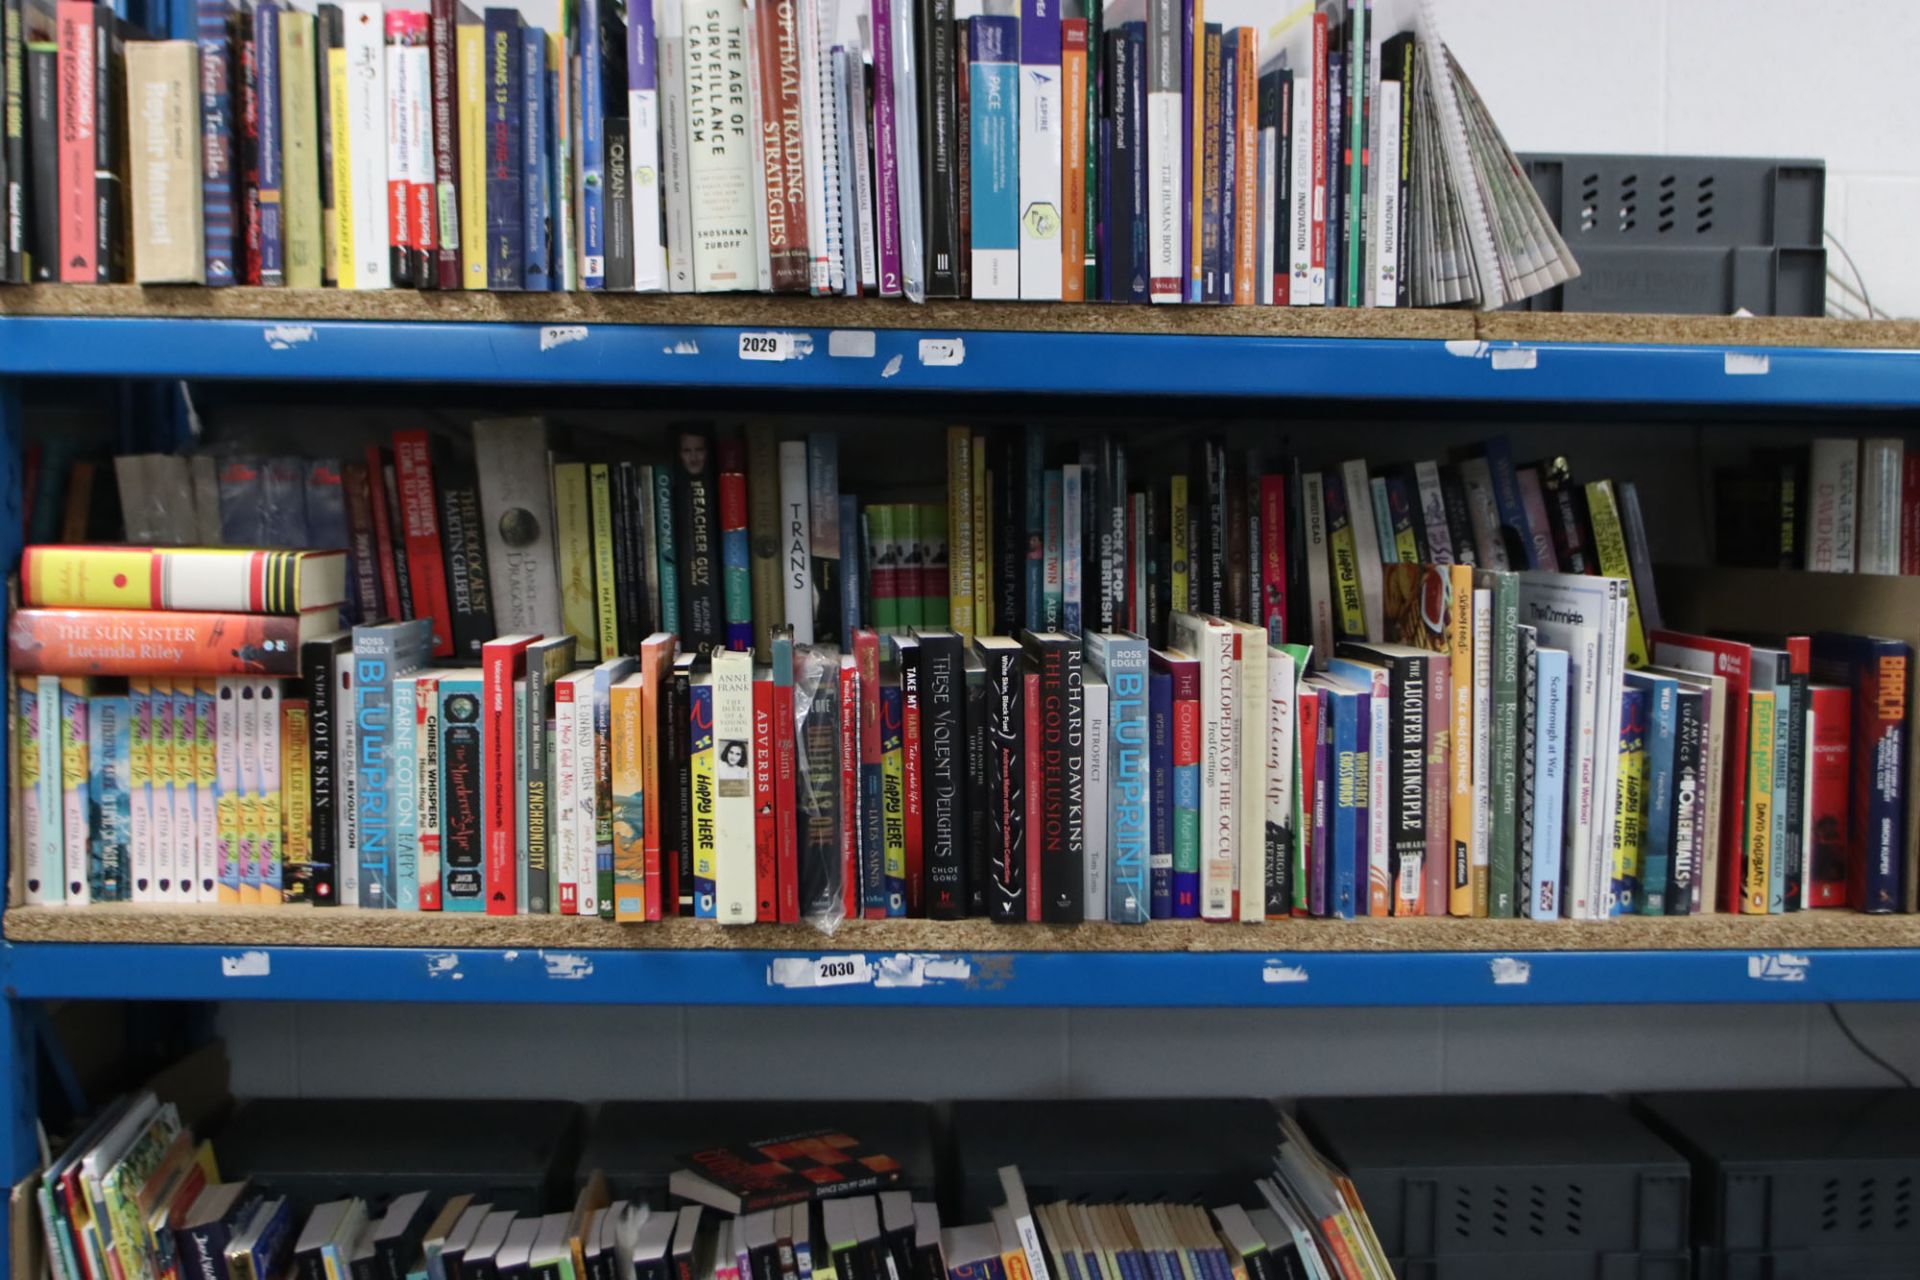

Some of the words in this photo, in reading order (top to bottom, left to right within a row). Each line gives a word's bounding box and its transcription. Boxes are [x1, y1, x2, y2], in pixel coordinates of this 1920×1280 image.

[64, 19, 75, 51] NEW
[727, 28, 741, 61] THE
[777, 2, 800, 100] OPTIMAL
[1116, 39, 1125, 63] Staff
[78, 24, 91, 125] INTRODUCING
[203, 40, 221, 107] African
[527, 44, 538, 74] Faith
[64, 56, 76, 142] ECONOMICS
[527, 77, 538, 99] and
[688, 25, 705, 143] CAPITALISM
[707, 10, 725, 156] SURVEILLANCE
[729, 70, 743, 105] AGE
[988, 76, 1001, 109] PACE
[1115, 64, 1126, 113] Well-Being
[79, 127, 90, 139] A
[141, 81, 170, 156] Repair
[528, 101, 539, 165] Resistance
[731, 115, 744, 136] OF
[1116, 115, 1126, 149] Journal
[206, 112, 223, 179] Textiles
[783, 104, 804, 203] TRADING
[1298, 144, 1307, 177] LENSES
[610, 143, 625, 198] QURAN
[764, 121, 786, 246] STRATEGIES
[1298, 179, 1306, 190] OF
[146, 162, 172, 245] Manual
[395, 182, 408, 241] Bescherelle
[697, 229, 749, 238] SHOSHANA
[1297, 192, 1306, 251] INNOVATION
[705, 241, 741, 249] ZUBOFF
[886, 272, 896, 288] 2
[741, 338, 777, 353] 2029
[693, 487, 707, 553] REACHER
[1112, 507, 1122, 548] ROCK
[790, 503, 805, 589] TRANS
[1101, 534, 1111, 555] ON
[1113, 553, 1123, 565] &
[695, 557, 709, 585] GUY
[1113, 569, 1123, 602] POP
[603, 587, 612, 615] MATT
[1101, 559, 1111, 622] BRITISH
[59, 624, 92, 641] THE
[95, 624, 134, 641] SUN
[137, 626, 196, 643] SISTER
[604, 617, 614, 642] HAIG
[1507, 607, 1517, 627] ROY
[66, 642, 136, 659] Lucinda
[140, 644, 183, 661] Riley
[354, 645, 390, 655] EDGLEY
[358, 637, 384, 645] ROSS
[1117, 650, 1143, 658] ROSS
[1505, 628, 1517, 682] STRONG
[718, 674, 749, 682] ANNE
[907, 667, 916, 691] TAKE
[932, 653, 951, 704] THESE
[1045, 649, 1060, 690] THE
[1111, 659, 1147, 667] EDGLEY
[1409, 660, 1420, 677] THE
[315, 665, 326, 707] UNDER
[495, 684, 502, 693] of
[717, 684, 749, 692] FRANK
[1000, 677, 1008, 694] Skin,
[1068, 650, 1082, 747] RICHARD
[1181, 674, 1192, 696] THE
[1220, 632, 1231, 754] ENCYCLOPEDIA
[1874, 656, 1906, 719] BARÇA
[907, 695, 917, 709] MY
[1001, 695, 1009, 715] Black
[1375, 704, 1383, 720] LISA
[1403, 680, 1422, 744] LUCIFER
[1546, 676, 1560, 742] Scarborough
[314, 710, 327, 760] YOUR
[345, 720, 353, 737] THE
[396, 688, 412, 750] FEARNE
[495, 711, 503, 752] Documents
[908, 713, 917, 739] HAND
[1046, 695, 1061, 743] GOD
[1180, 703, 1192, 762] COMFORT
[1207, 721, 1217, 743] Fred
[1265, 698, 1288, 769] Packing
[1503, 703, 1516, 758] Remaking
[1776, 709, 1787, 740] BLACK
[345, 739, 354, 758] RED
[427, 716, 436, 765] CHINESE
[757, 710, 769, 793] ADVERBS
[934, 710, 955, 780] VIOLENT
[1091, 718, 1102, 783] RETROSPECT
[1375, 722, 1383, 758] WILLIAMS
[1547, 744, 1557, 754] at
[346, 760, 354, 777] PILL
[358, 660, 389, 877] BLUEPRINT
[495, 754, 503, 770] from
[495, 771, 503, 782] the
[1207, 746, 1218, 788] Gettings
[1220, 757, 1230, 778] OF
[1375, 759, 1383, 773] THE
[1504, 761, 1513, 769] a
[1546, 758, 1557, 778] War
[1581, 758, 1590, 785] Facial
[1775, 743, 1786, 789] TOMMIES
[315, 765, 329, 808] SKIN
[398, 756, 413, 827] COTTON
[417, 758, 426, 811] Hsiao-Hung
[495, 783, 503, 808] Global
[695, 774, 713, 815] HAPPY
[1115, 673, 1143, 891] BLUEPRINT
[1181, 770, 1193, 807] BOOK
[1269, 777, 1283, 805] Up
[1338, 751, 1354, 808] CROSSWORDS
[1374, 775, 1383, 808] SURVIVAL
[1402, 749, 1422, 830] PRINCIPLE
[1503, 772, 1515, 814] Garden
[428, 769, 437, 828] WHISPERS
[1045, 749, 1061, 851] DELUSION
[1068, 757, 1082, 852] DAWKINS
[1220, 781, 1230, 812] THE
[1580, 787, 1590, 825] Workout
[347, 779, 356, 849] REVOLUTION
[418, 813, 426, 828] Pai
[495, 810, 503, 828] North
[529, 781, 545, 870] SYNCHRONICITY
[934, 786, 956, 858] DELIGHTS
[1181, 814, 1193, 840] Matt
[1374, 821, 1382, 833] THE
[1375, 809, 1382, 820] OF
[1755, 803, 1766, 832] DAVID
[1775, 814, 1783, 831] RAY
[697, 817, 713, 850] HERE
[1374, 834, 1382, 855] SOUL
[1881, 818, 1890, 845] SIMON
[398, 833, 414, 879] HAPPY
[1180, 841, 1193, 869] Haig
[1275, 843, 1285, 884] BRIGID
[1774, 833, 1783, 878] COSTELLO
[1880, 847, 1890, 874] KUPER
[819, 961, 855, 978] 2030
